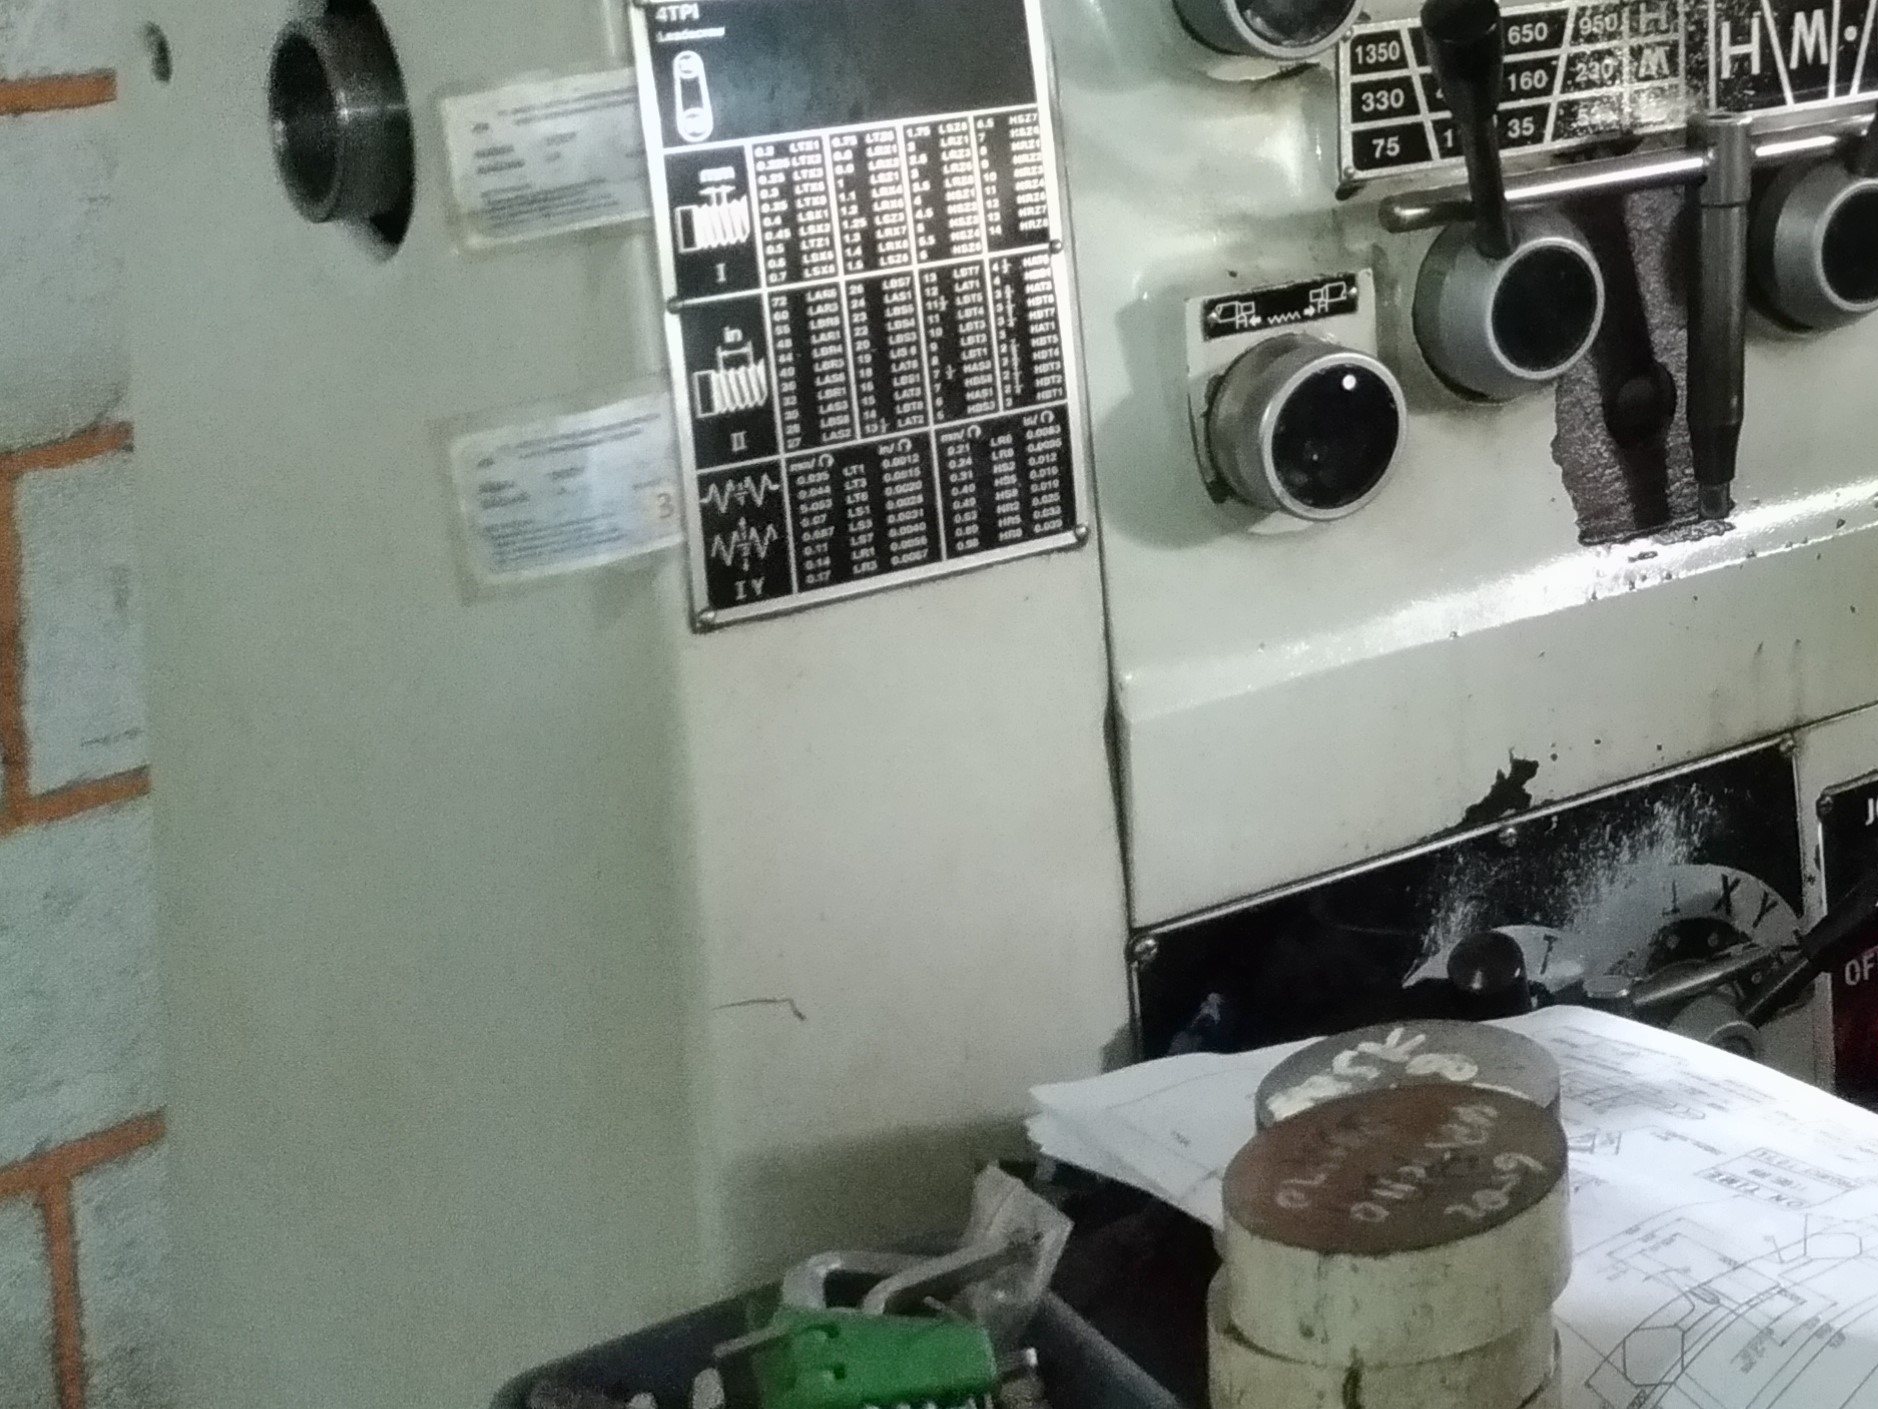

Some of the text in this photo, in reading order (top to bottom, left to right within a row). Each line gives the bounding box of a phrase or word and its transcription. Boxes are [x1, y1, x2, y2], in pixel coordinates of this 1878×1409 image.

[655, 2, 699, 21] 4TPI
[1354, 40, 1401, 65] 1350
[1506, 21, 1549, 45] 650
[1578, 12, 1618, 37] 950
[1720, 14, 1761, 80] H
[1789, 8, 1829, 70] M
[1360, 87, 1406, 113] 330
[1506, 69, 1549, 93] 160
[977, 131, 985, 142] 7
[1371, 135, 1401, 160] 75
[1506, 116, 1536, 139] 35
[982, 170, 997, 182] 10
[983, 184, 996, 195] 11
[764, 227, 791, 241] 0.45
[988, 224, 1002, 235] 14
[765, 242, 784, 255] 0.5
[844, 245, 862, 257] 1.4
[768, 270, 786, 283] 0.7
[924, 286, 938, 296] 12
[723, 326, 742, 342] in
[1712, 873, 1742, 917] X
[1752, 889, 1779, 929] Y
